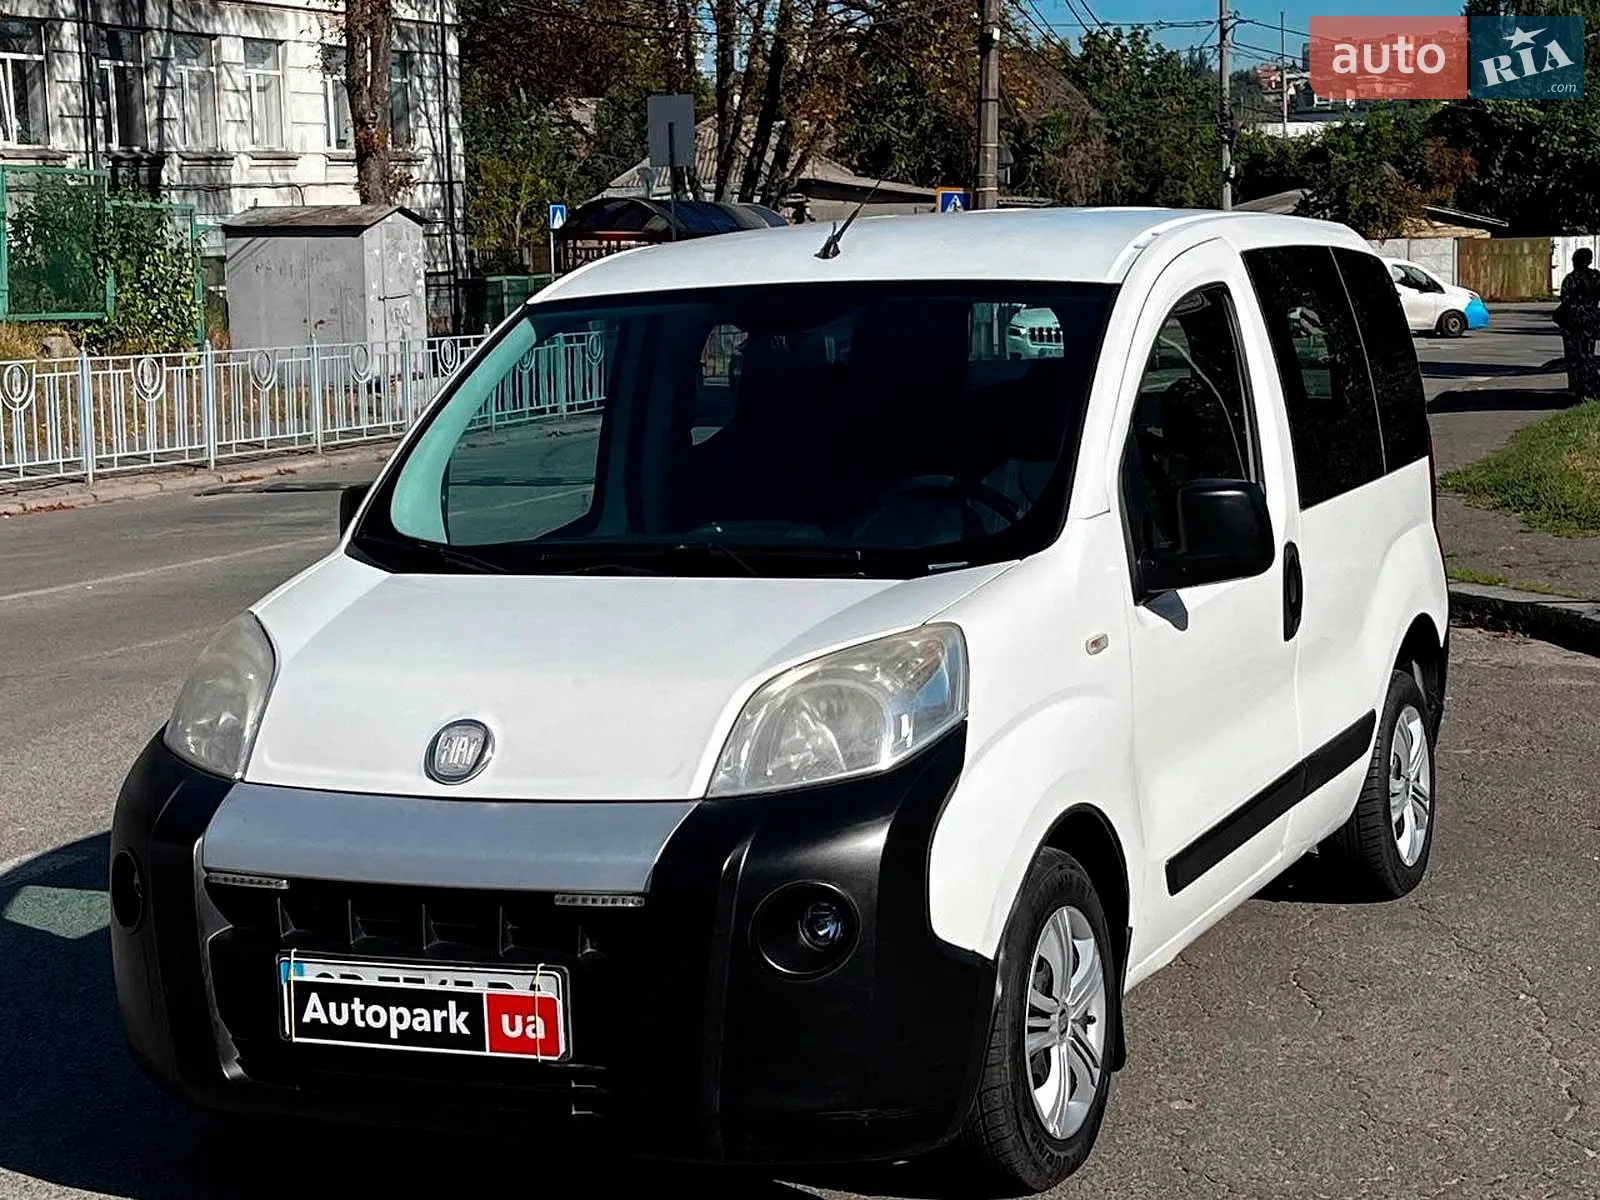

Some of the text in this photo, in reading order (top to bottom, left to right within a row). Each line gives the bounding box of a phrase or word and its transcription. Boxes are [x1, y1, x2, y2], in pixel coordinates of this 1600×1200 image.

[440, 735, 481, 765] FIAT
[302, 992, 546, 1040] Autopark ua
